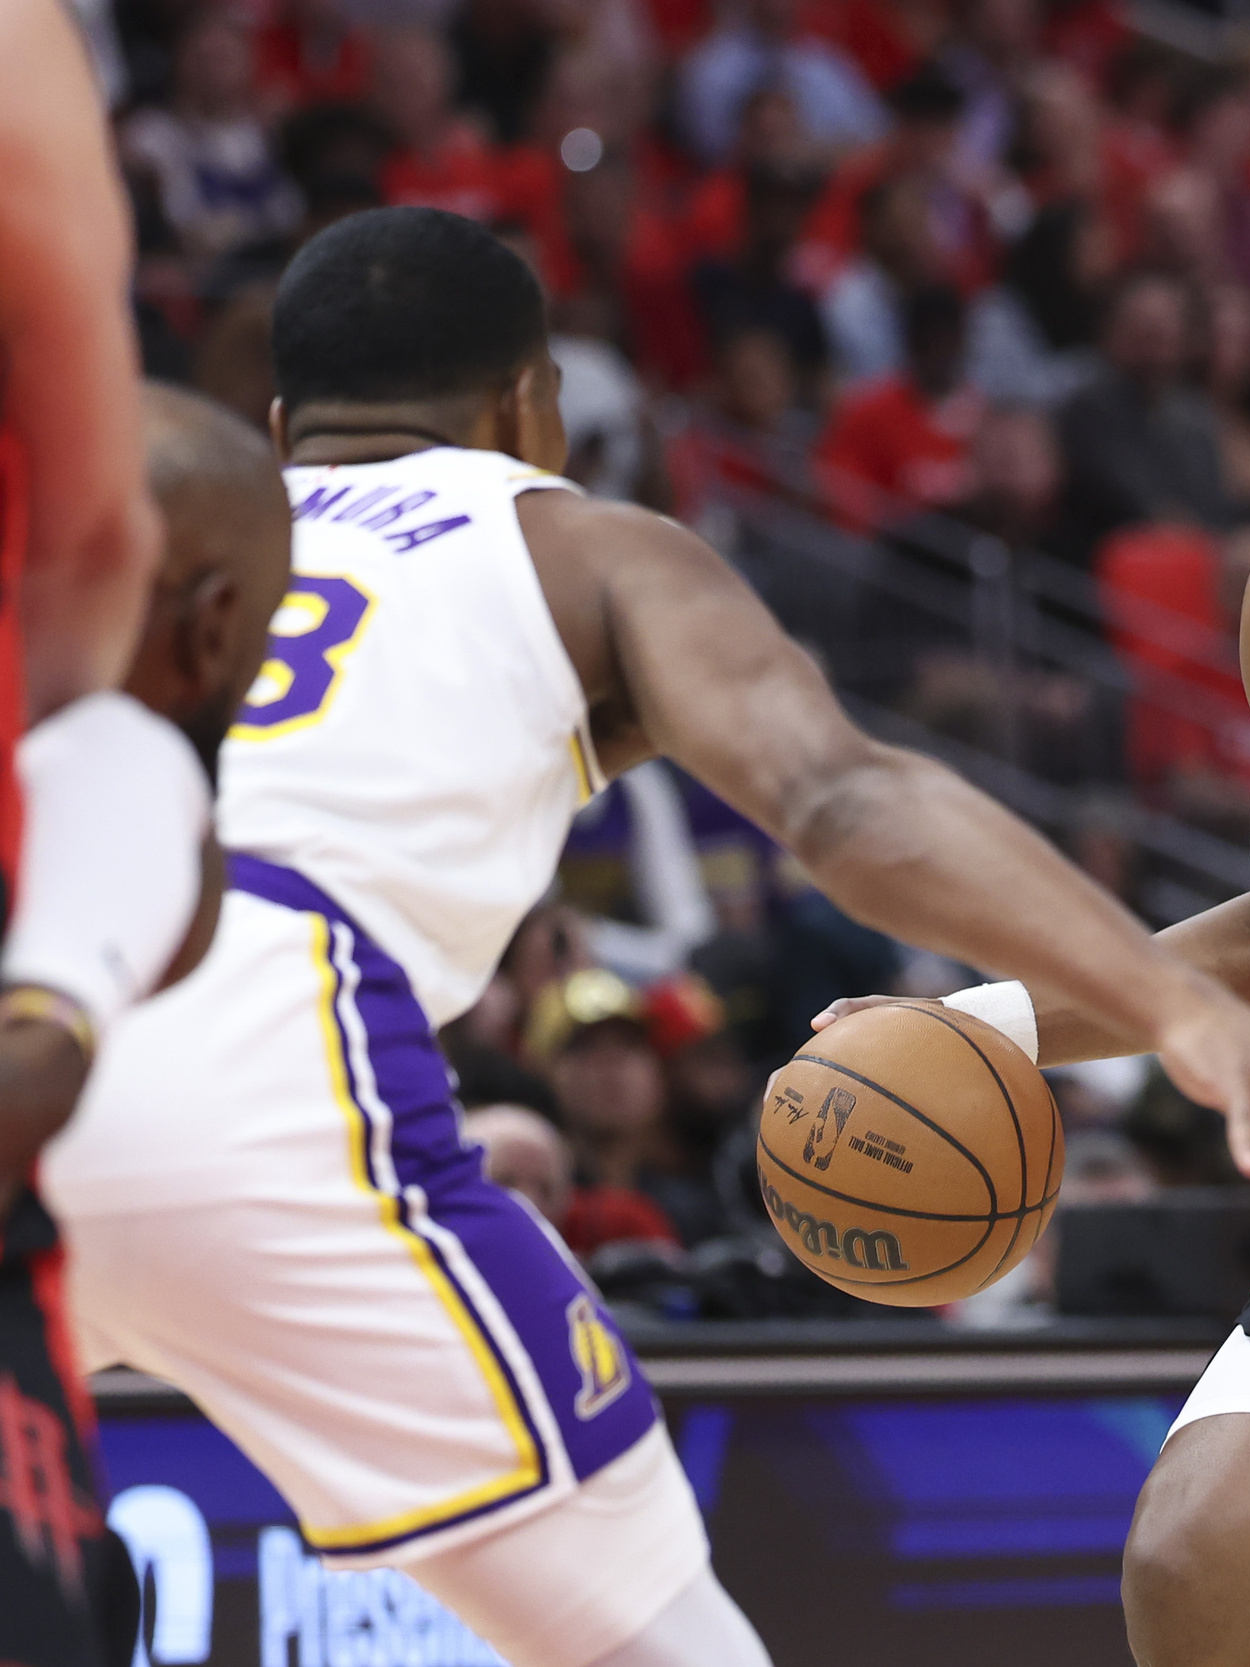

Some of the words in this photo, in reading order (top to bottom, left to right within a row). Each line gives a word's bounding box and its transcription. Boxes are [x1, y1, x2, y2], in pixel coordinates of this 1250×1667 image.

[848, 1135, 866, 1153] BALL
[863, 1142, 884, 1161] GAME
[882, 1151, 914, 1174] OFFICIAL
